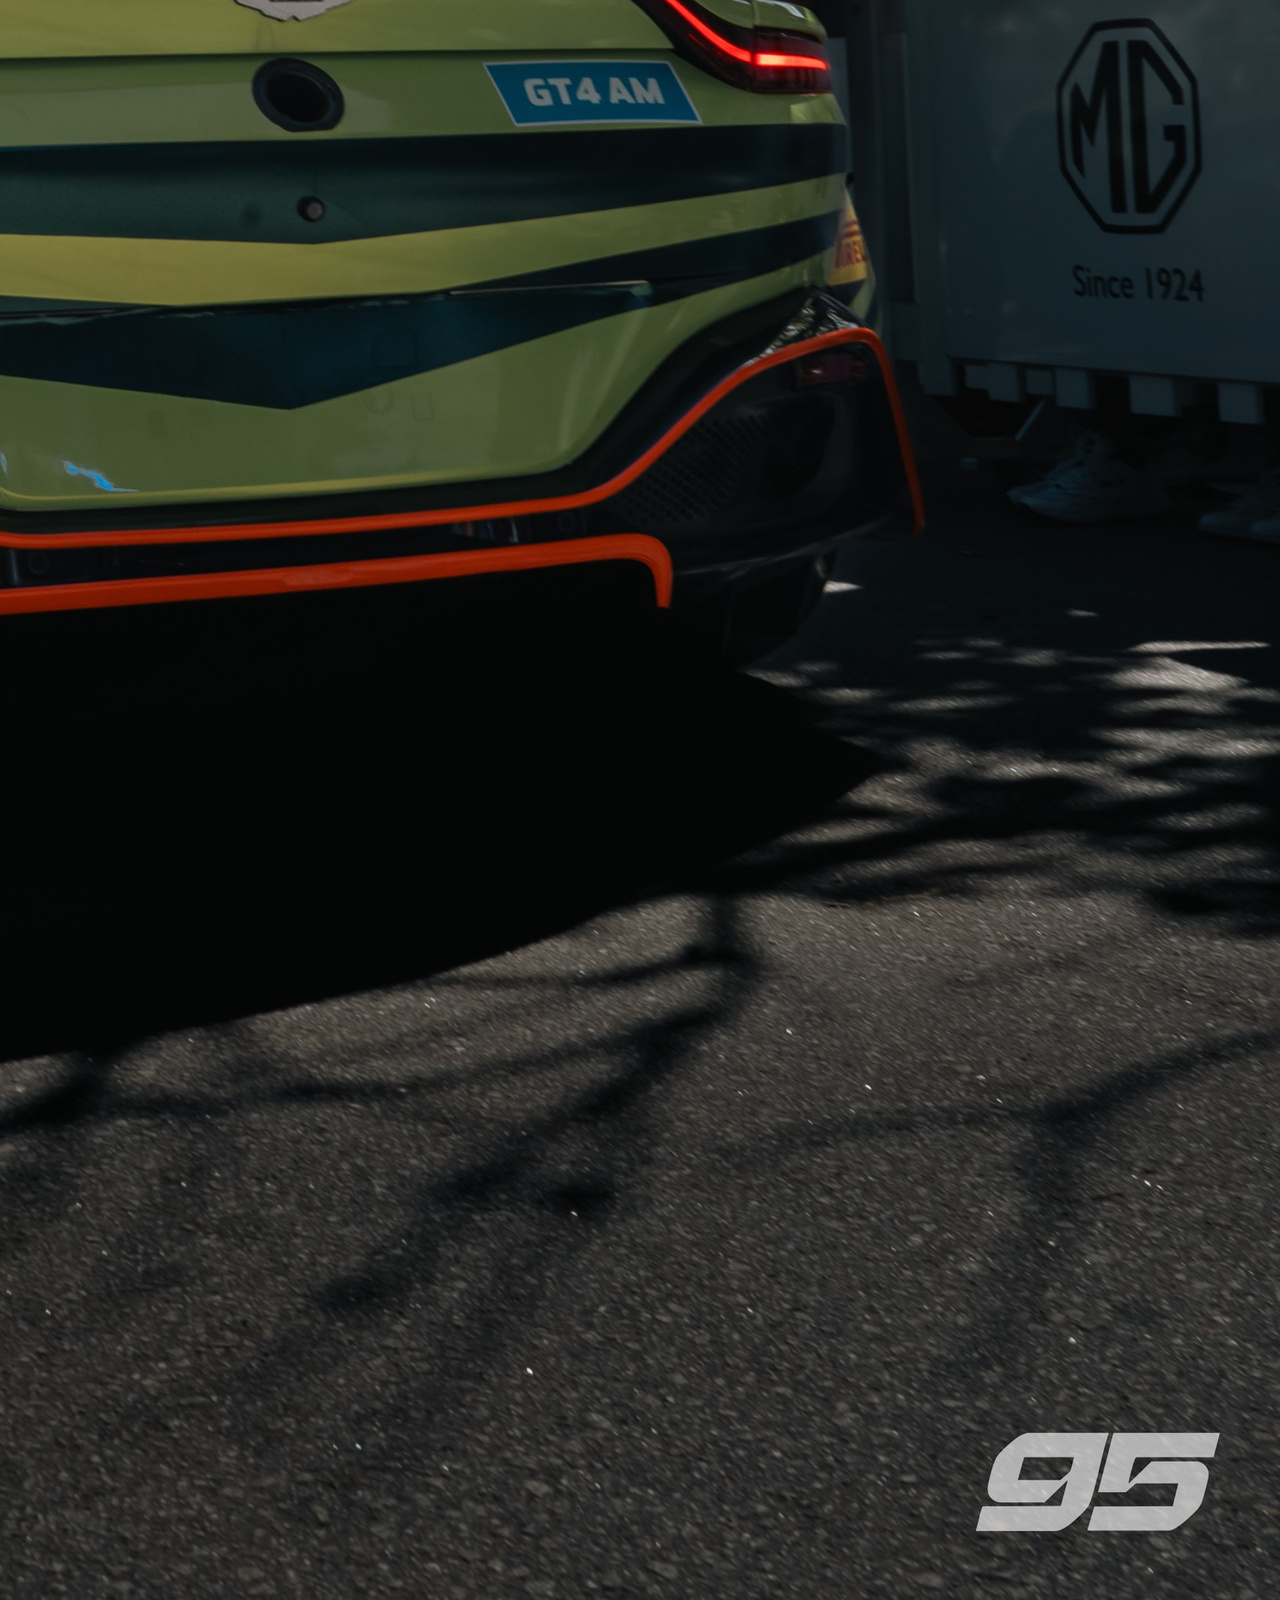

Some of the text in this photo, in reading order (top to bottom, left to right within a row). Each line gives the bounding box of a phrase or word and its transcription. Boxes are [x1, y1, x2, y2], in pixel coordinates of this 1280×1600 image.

[523, 77, 666, 106] GT4 AM
[1071, 39, 1186, 213] MG
[1073, 264, 1204, 302] Since 1924
